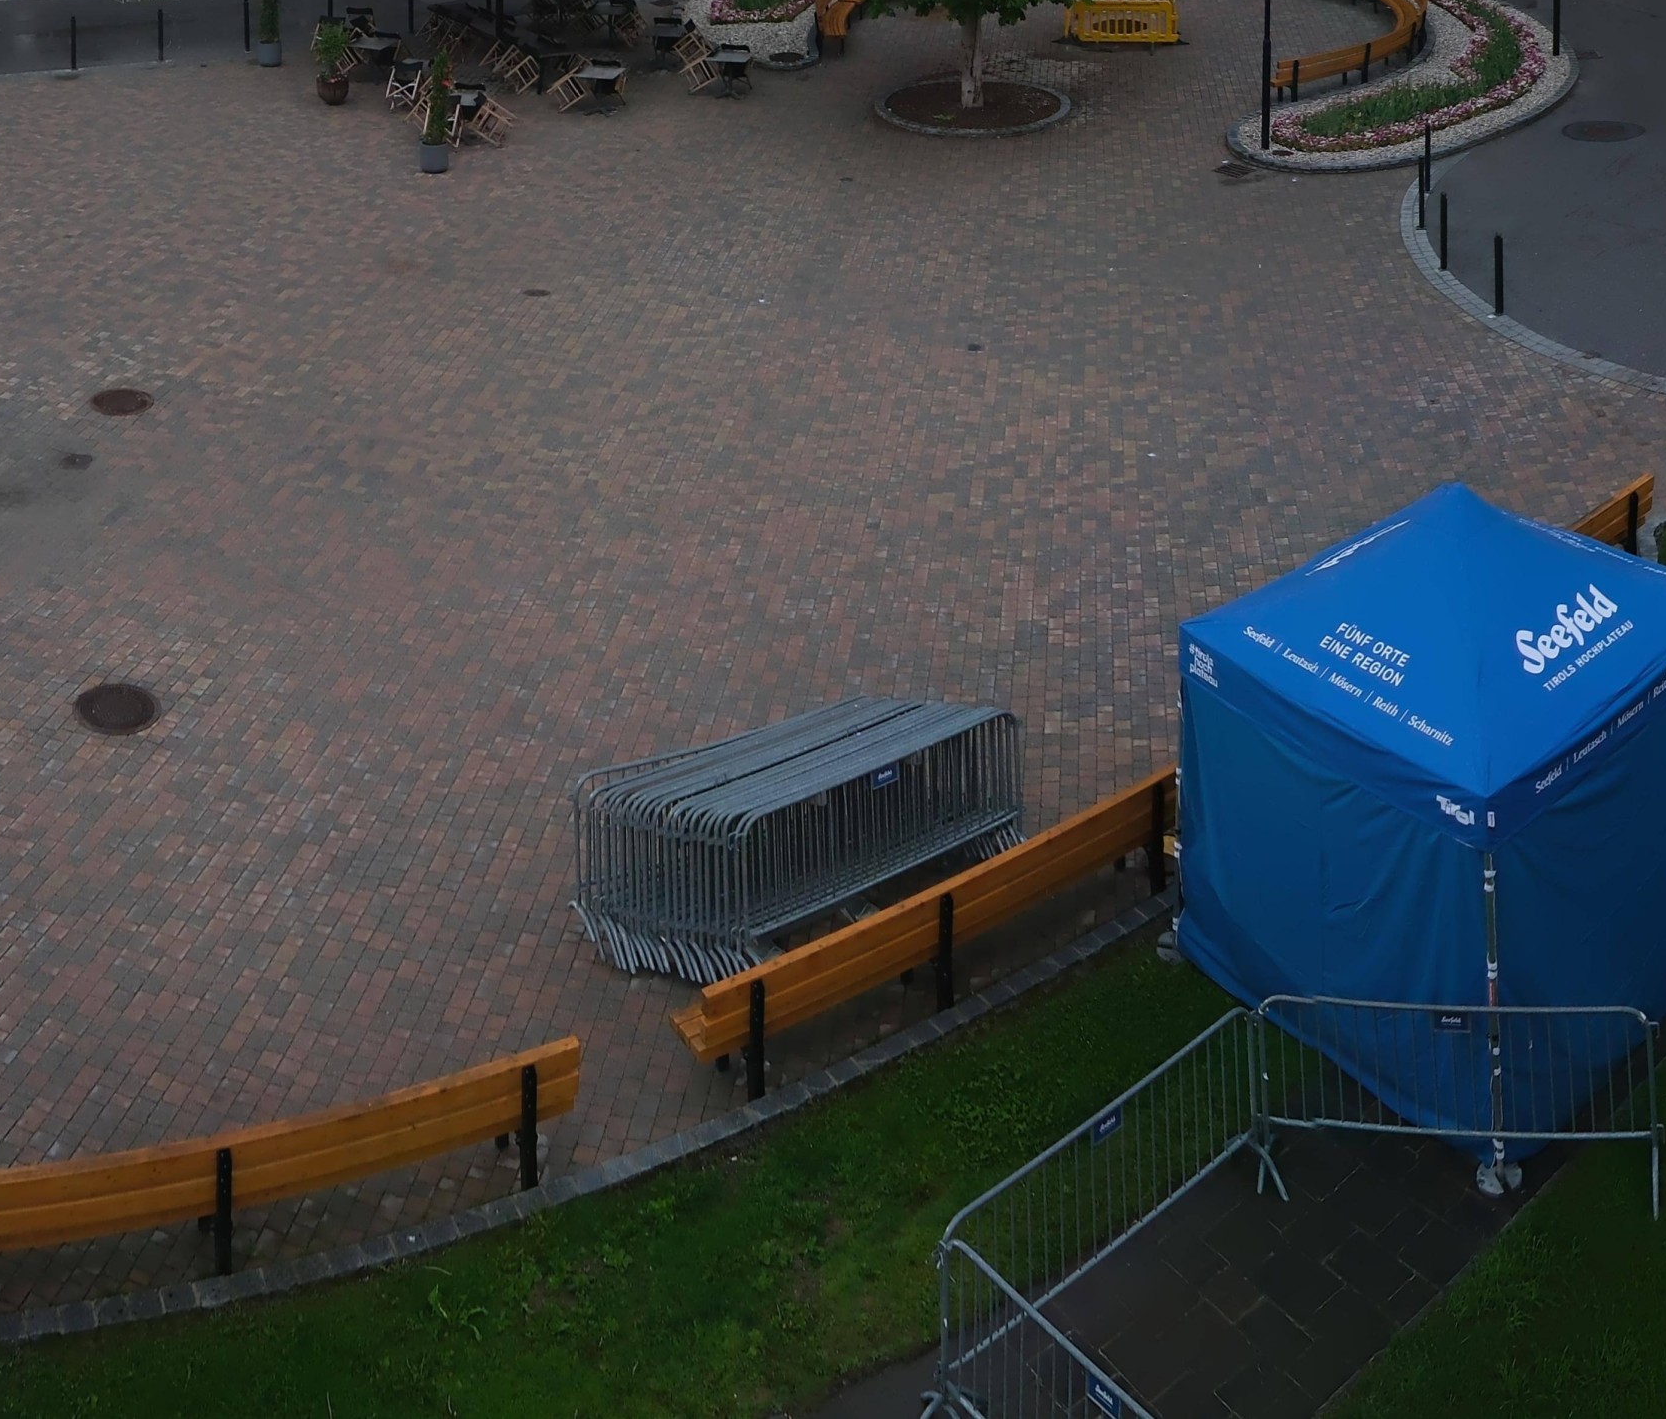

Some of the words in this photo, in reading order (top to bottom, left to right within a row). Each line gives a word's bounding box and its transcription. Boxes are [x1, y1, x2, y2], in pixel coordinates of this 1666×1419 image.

[1319, 635, 1350, 660] EINE
[1351, 653, 1405, 687] REGION
[1336, 622, 1374, 648] FÜNF
[1373, 640, 1410, 668] ORTE
[1515, 583, 1619, 675] Seefeld
[1542, 664, 1576, 692] TIROLS
[1577, 619, 1634, 669] HOCHPLATEAU
[1242, 625, 1276, 650] Seefeld
[1282, 647, 1320, 675] Leutasch
[1328, 672, 1363, 698] Mösern
[1372, 696, 1399, 717] Reith
[1407, 715, 1454, 746] Scharnitz
[1535, 763, 1563, 795] Seefeld
[1573, 730, 1607, 765] Leutasch
[1436, 794, 1475, 826] Tirol
